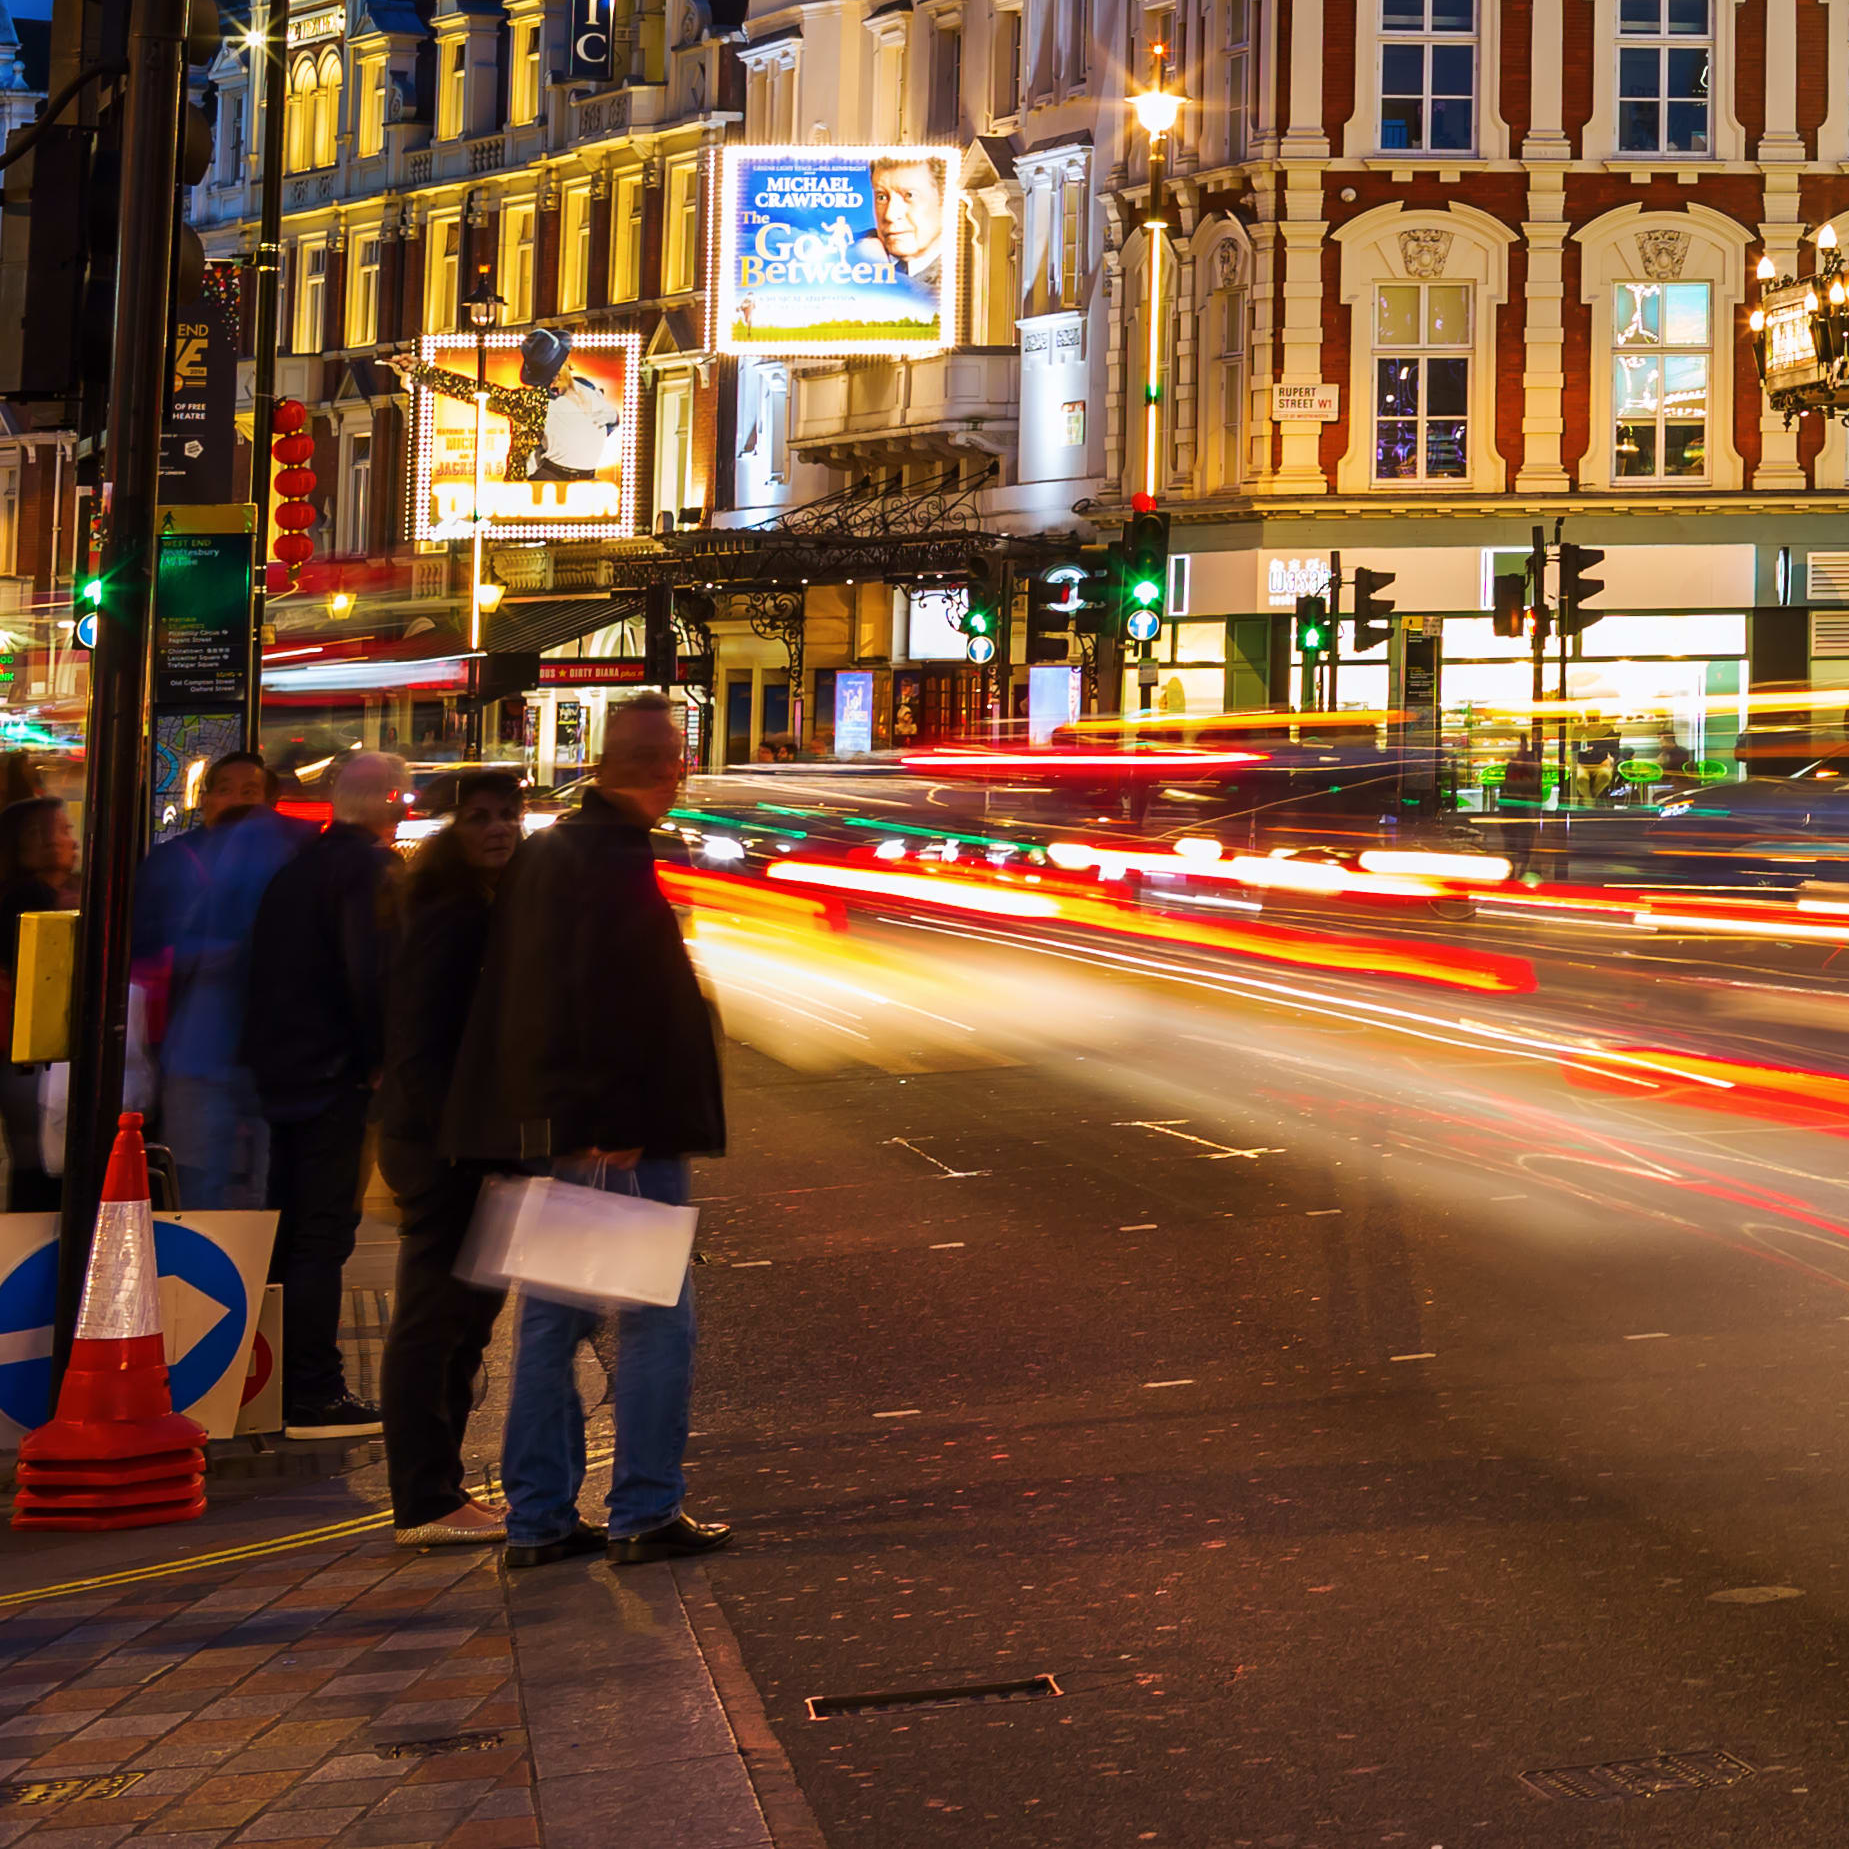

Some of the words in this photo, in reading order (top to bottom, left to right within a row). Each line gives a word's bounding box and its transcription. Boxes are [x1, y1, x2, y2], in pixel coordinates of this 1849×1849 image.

[766, 177, 853, 192] MICHAEL
[754, 192, 863, 208] CRAWFORD
[741, 211, 770, 224] The
[739, 255, 897, 288] Between
[177, 324, 208, 337] END
[1279, 387, 1317, 397] RUPERT
[1279, 398, 1314, 409] STREET
[1318, 399, 1332, 409] W1
[173, 412, 206, 420] HEATRE
[569, 667, 592, 679] DIRTY
[595, 666, 620, 678] DIANA
